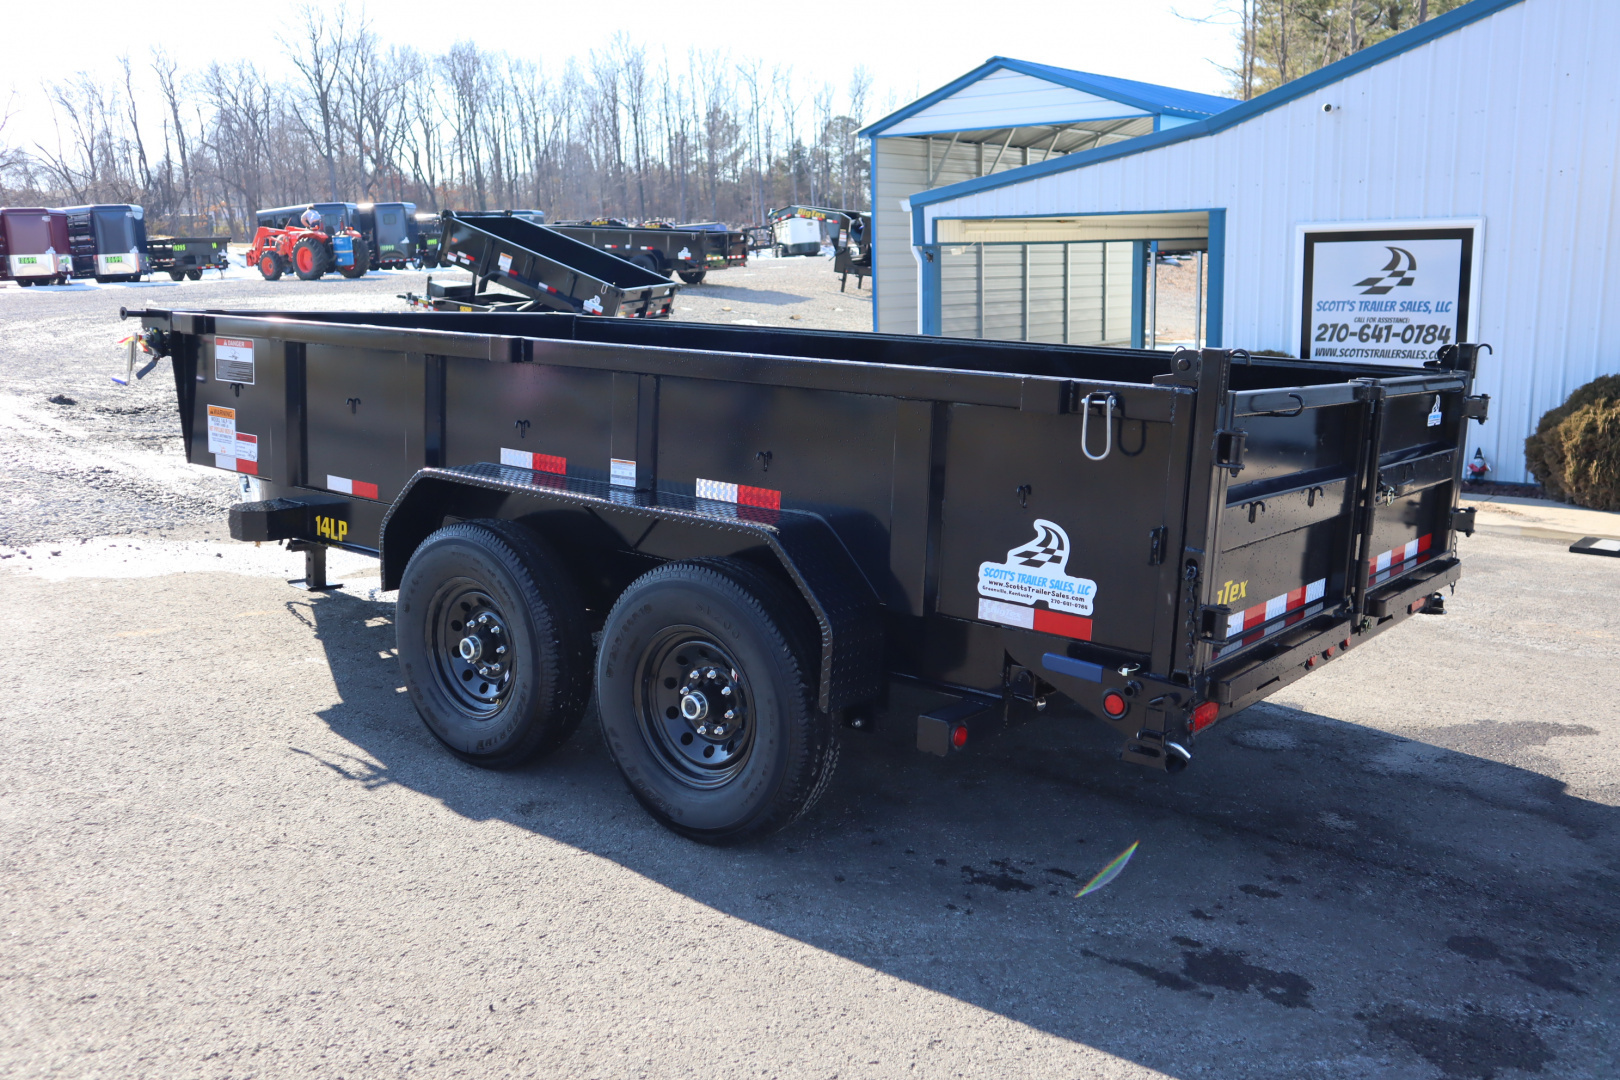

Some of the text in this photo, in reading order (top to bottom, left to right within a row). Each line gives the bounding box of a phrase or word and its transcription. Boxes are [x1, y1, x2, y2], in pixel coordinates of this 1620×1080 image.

[1316, 300, 1453, 314] SCOTT'S TRAILER SALES, LLC
[227, 339, 245, 347] DANGER
[1315, 323, 1451, 344] 270-641-0784
[213, 410, 233, 418] WARNING
[315, 515, 348, 541] 14LP
[983, 567, 1092, 595] SCOTT'S TRAILER SALES, LLC
[988, 580, 1085, 602] www.ScottsTrailerSales.com
